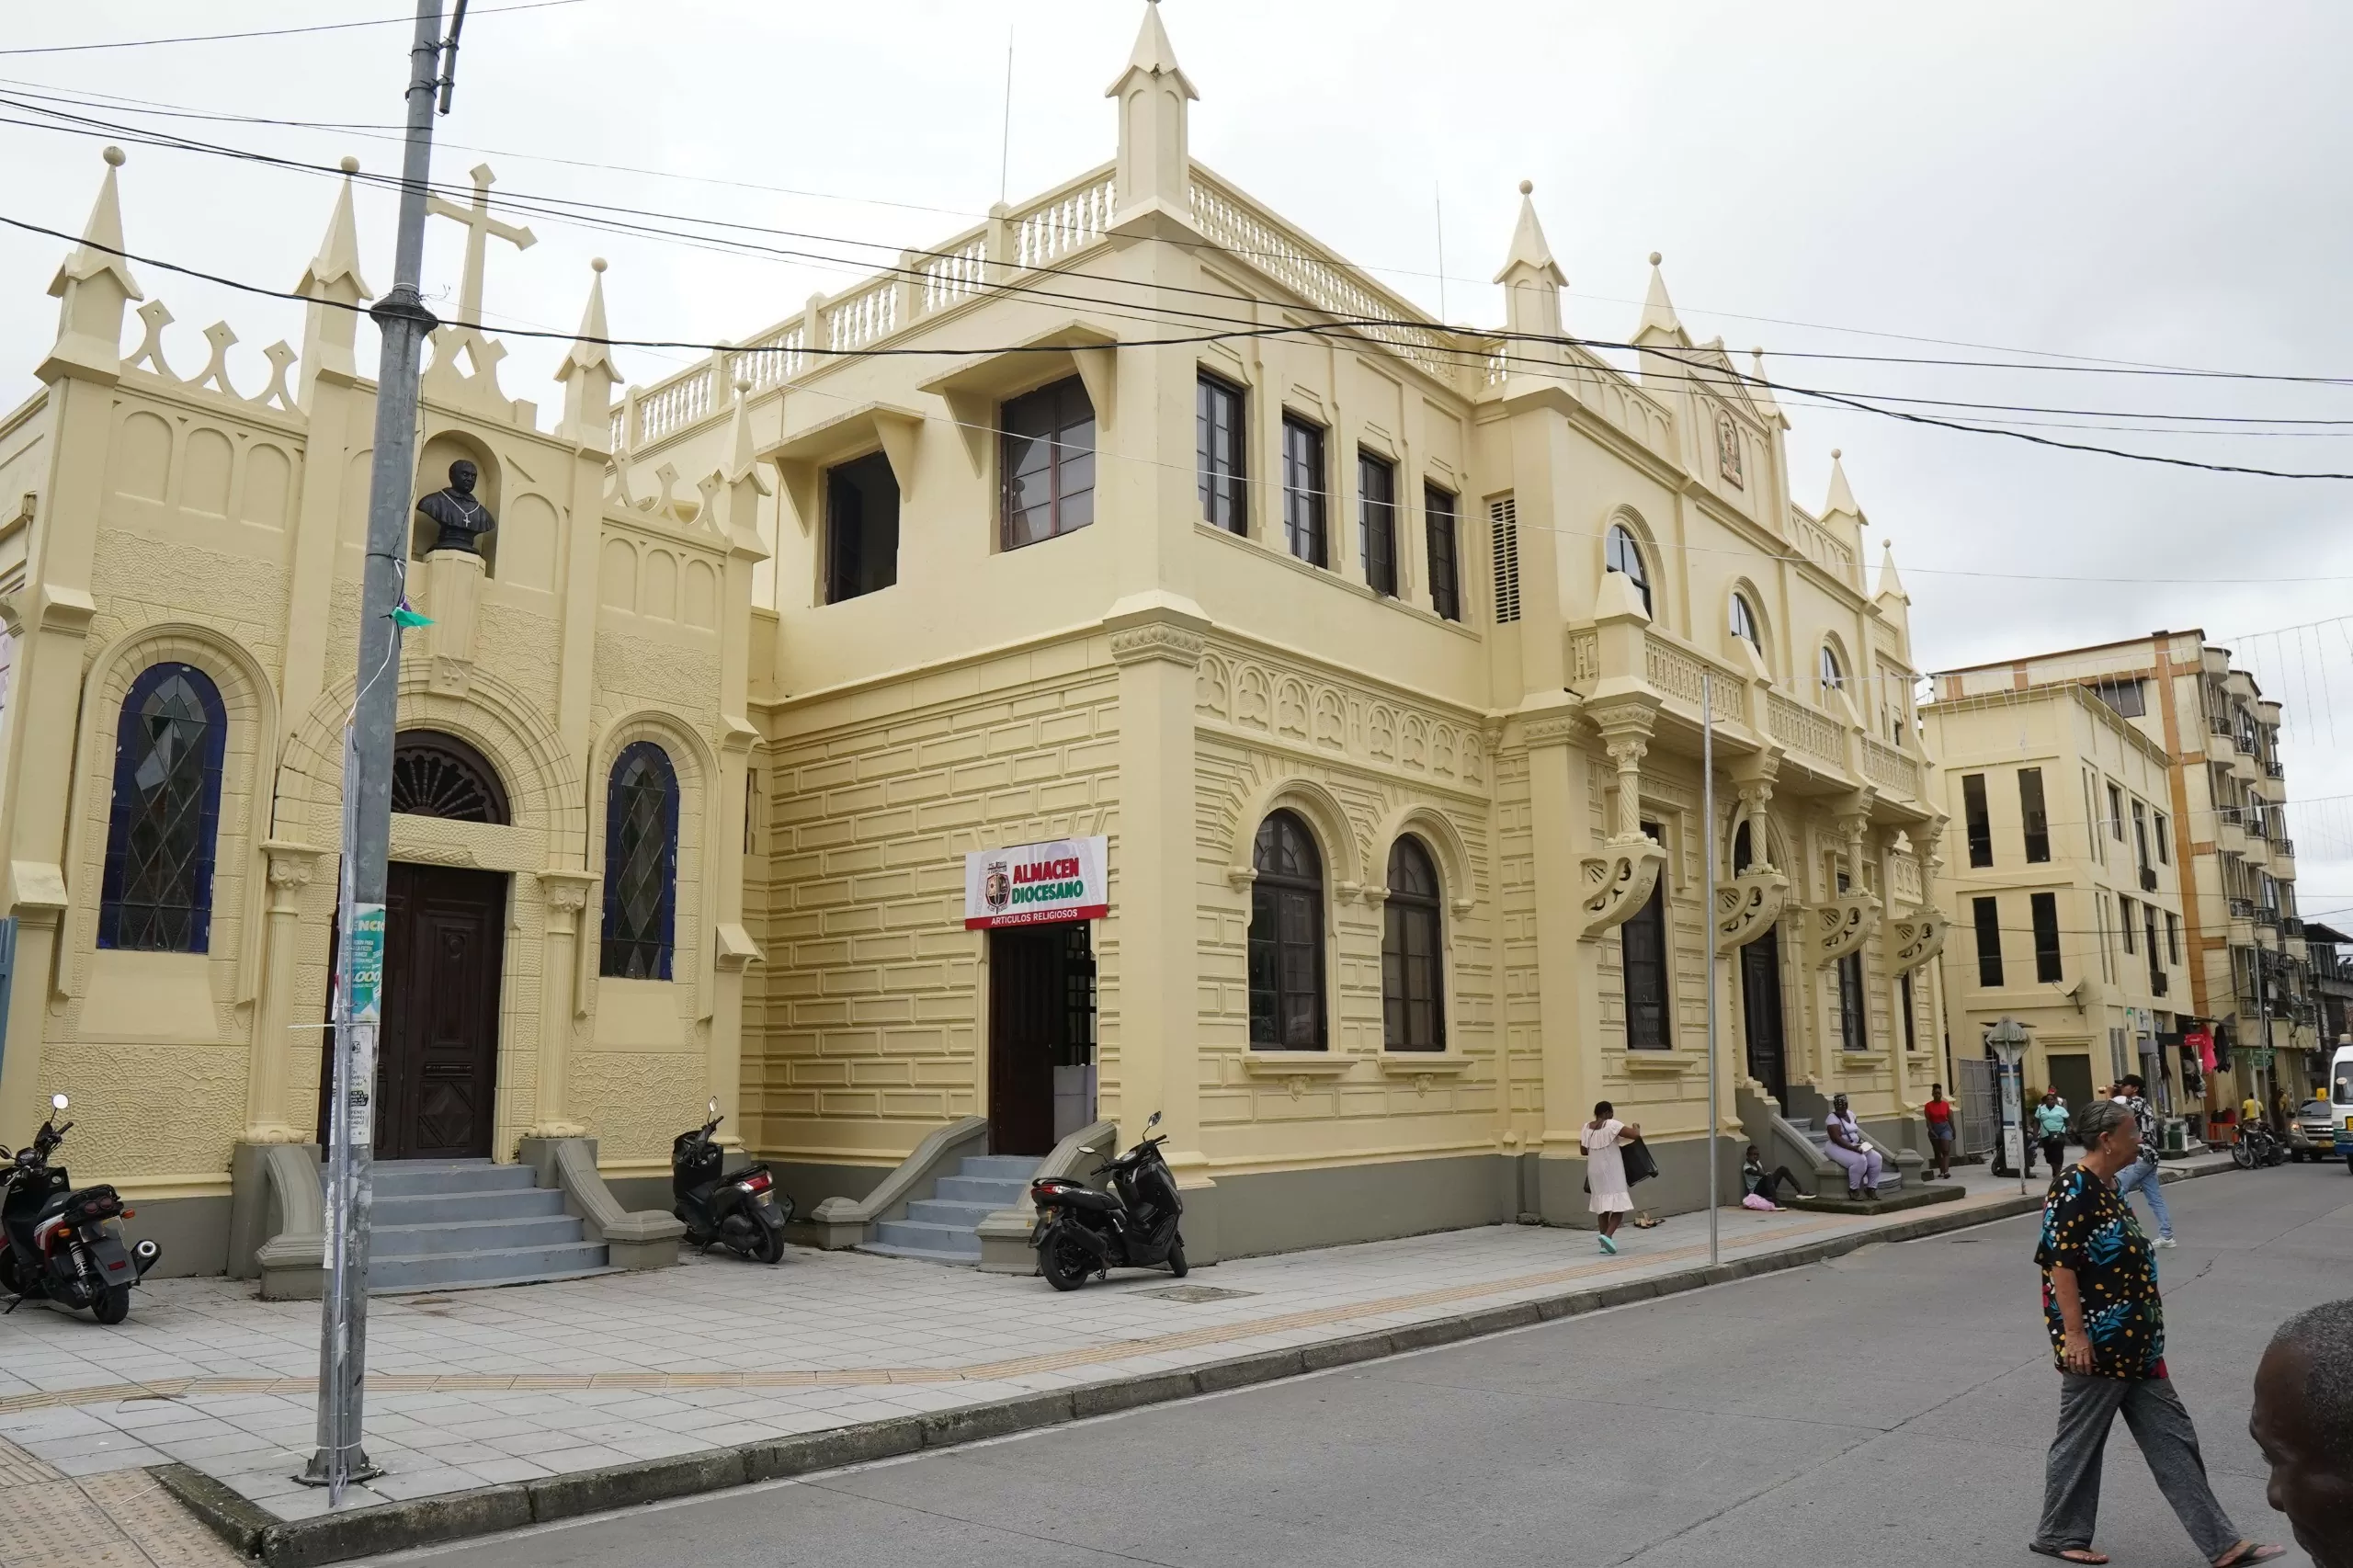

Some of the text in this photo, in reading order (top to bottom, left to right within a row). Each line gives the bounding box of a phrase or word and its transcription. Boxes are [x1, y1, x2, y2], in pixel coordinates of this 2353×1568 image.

[1013, 858, 1080, 884] ALMACEN
[1012, 881, 1084, 904] DIOCESANO
[991, 909, 1078, 926] ARTICULOS RELIGIOSOS
